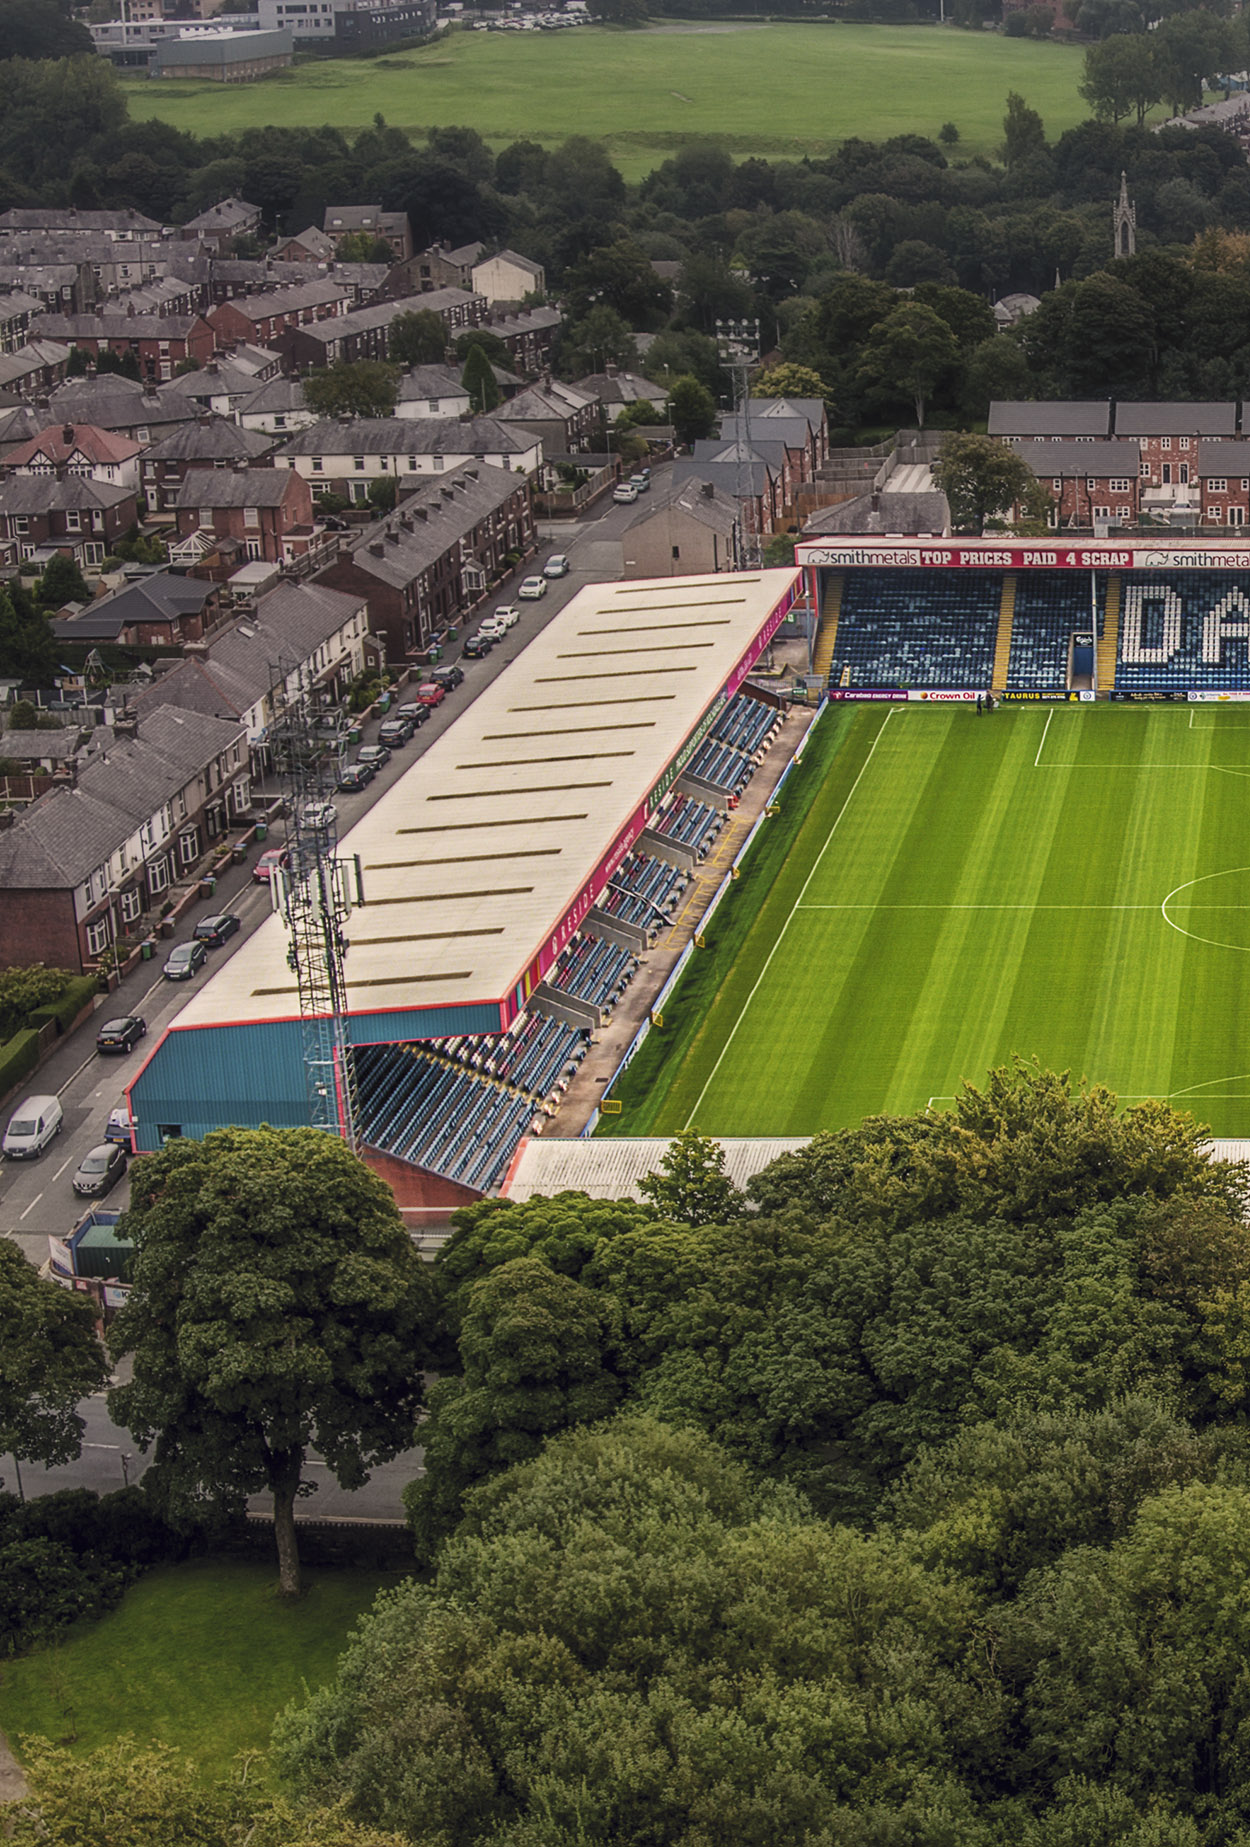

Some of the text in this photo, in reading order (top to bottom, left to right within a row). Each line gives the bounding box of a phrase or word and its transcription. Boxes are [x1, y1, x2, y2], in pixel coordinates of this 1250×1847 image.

[831, 550, 917, 565] smithmetals
[922, 551, 1129, 565] TOP PRICES PAID 4 SCRAP
[650, 767, 674, 809] RESIDE
[562, 883, 594, 942] RESIDE
